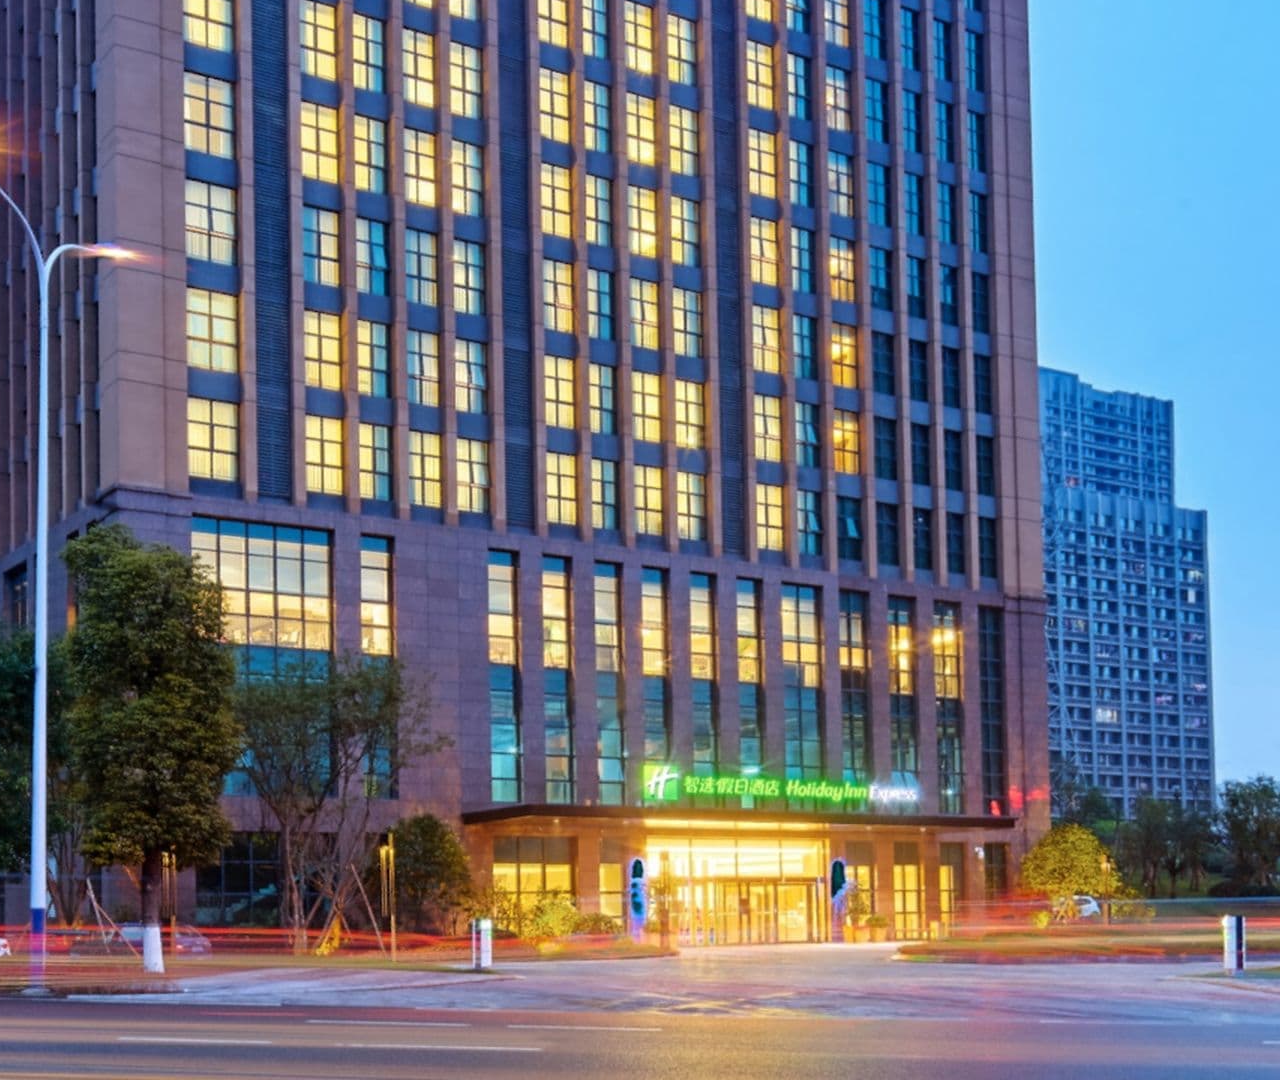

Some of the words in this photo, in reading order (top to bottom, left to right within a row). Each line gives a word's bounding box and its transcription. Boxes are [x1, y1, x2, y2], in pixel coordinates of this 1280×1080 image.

[684, 775, 779, 796] 智选假日酒店
[785, 779, 844, 802] Holiday
[844, 781, 867, 798] Inn
[870, 784, 918, 802] Express
